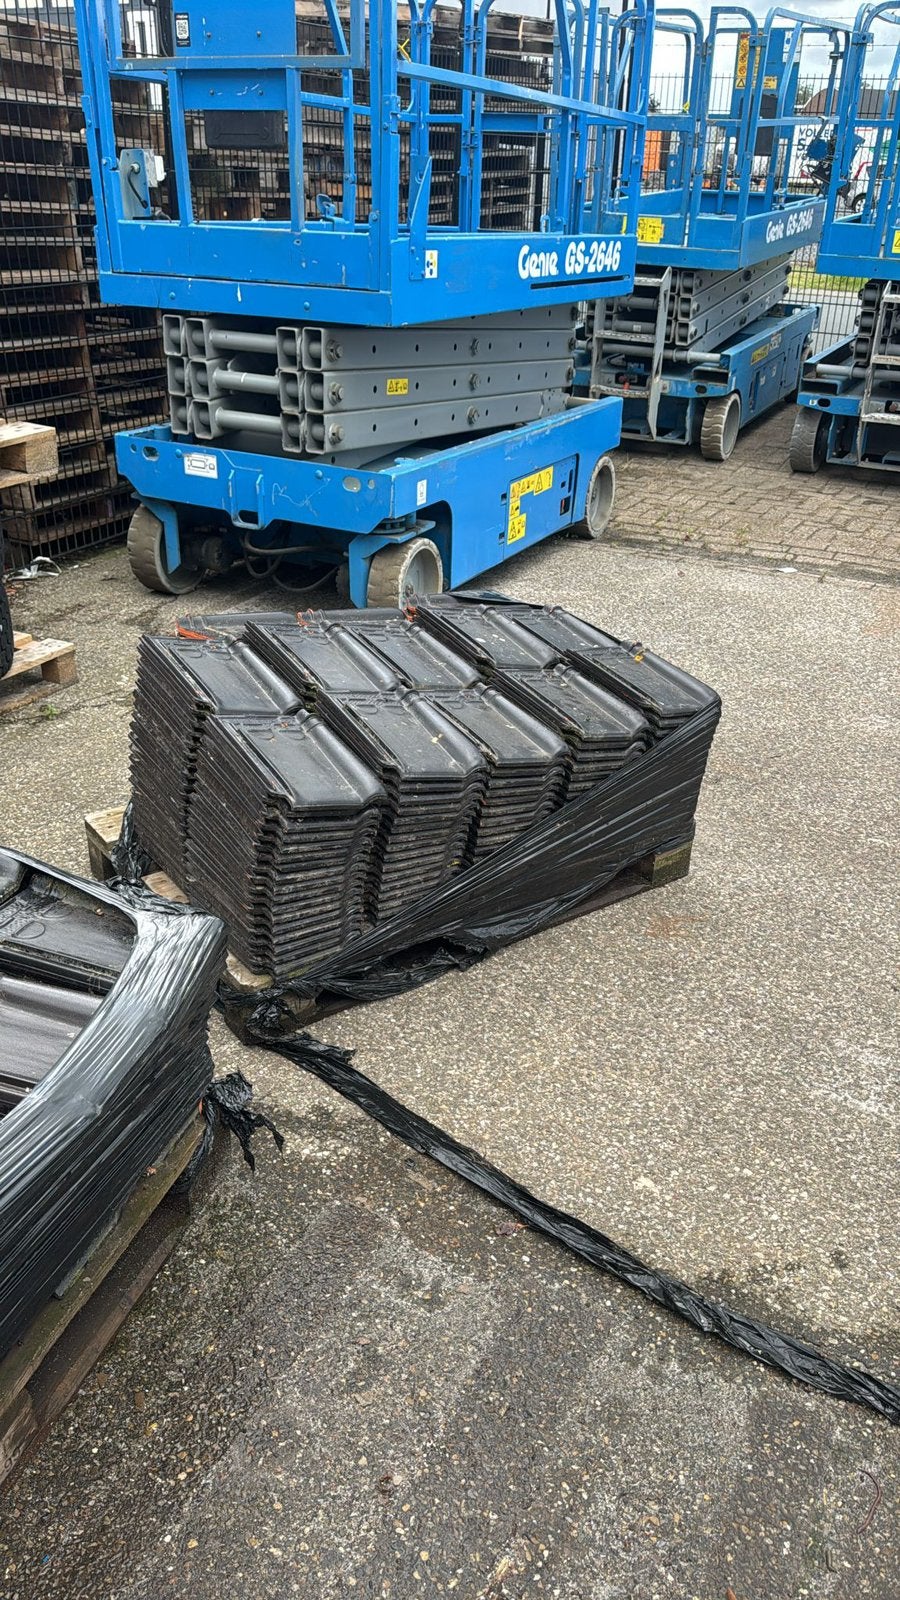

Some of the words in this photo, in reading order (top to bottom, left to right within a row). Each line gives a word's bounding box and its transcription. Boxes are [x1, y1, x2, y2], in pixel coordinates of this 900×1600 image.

[766, 218, 785, 244] Genie
[786, 208, 814, 237] GS-2646
[518, 244, 559, 280] Genie
[565, 240, 622, 275] GS-2646
